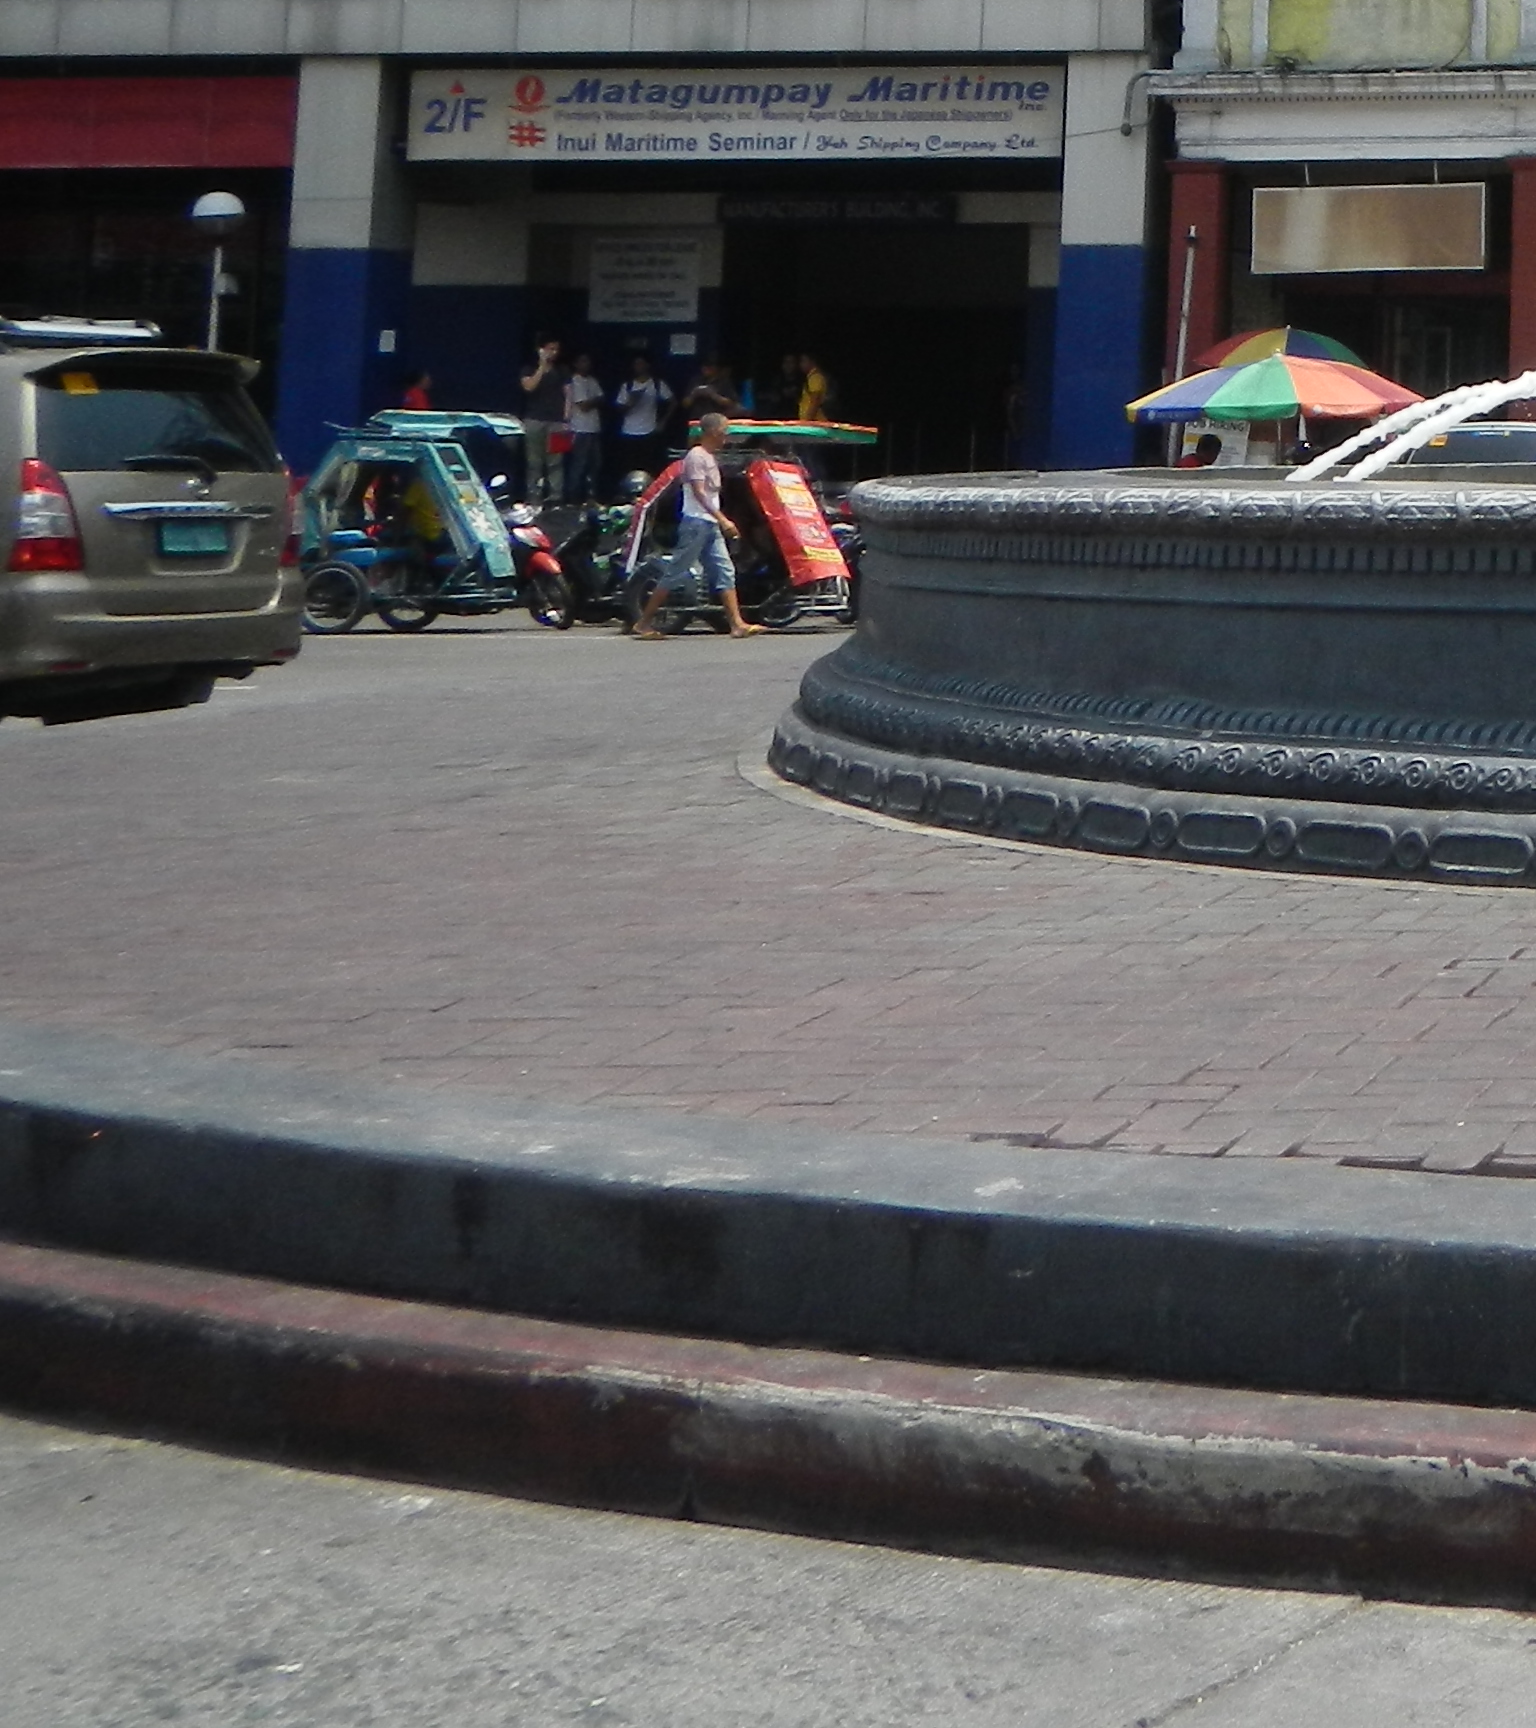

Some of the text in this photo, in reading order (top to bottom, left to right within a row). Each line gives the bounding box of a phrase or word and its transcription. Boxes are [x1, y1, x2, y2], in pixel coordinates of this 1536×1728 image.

[556, 74, 1049, 110] Matagumpay Maritime
[423, 98, 488, 134] 2/F
[557, 133, 597, 151] Inui
[605, 133, 698, 152] Maritime
[708, 132, 796, 152] Seminar
